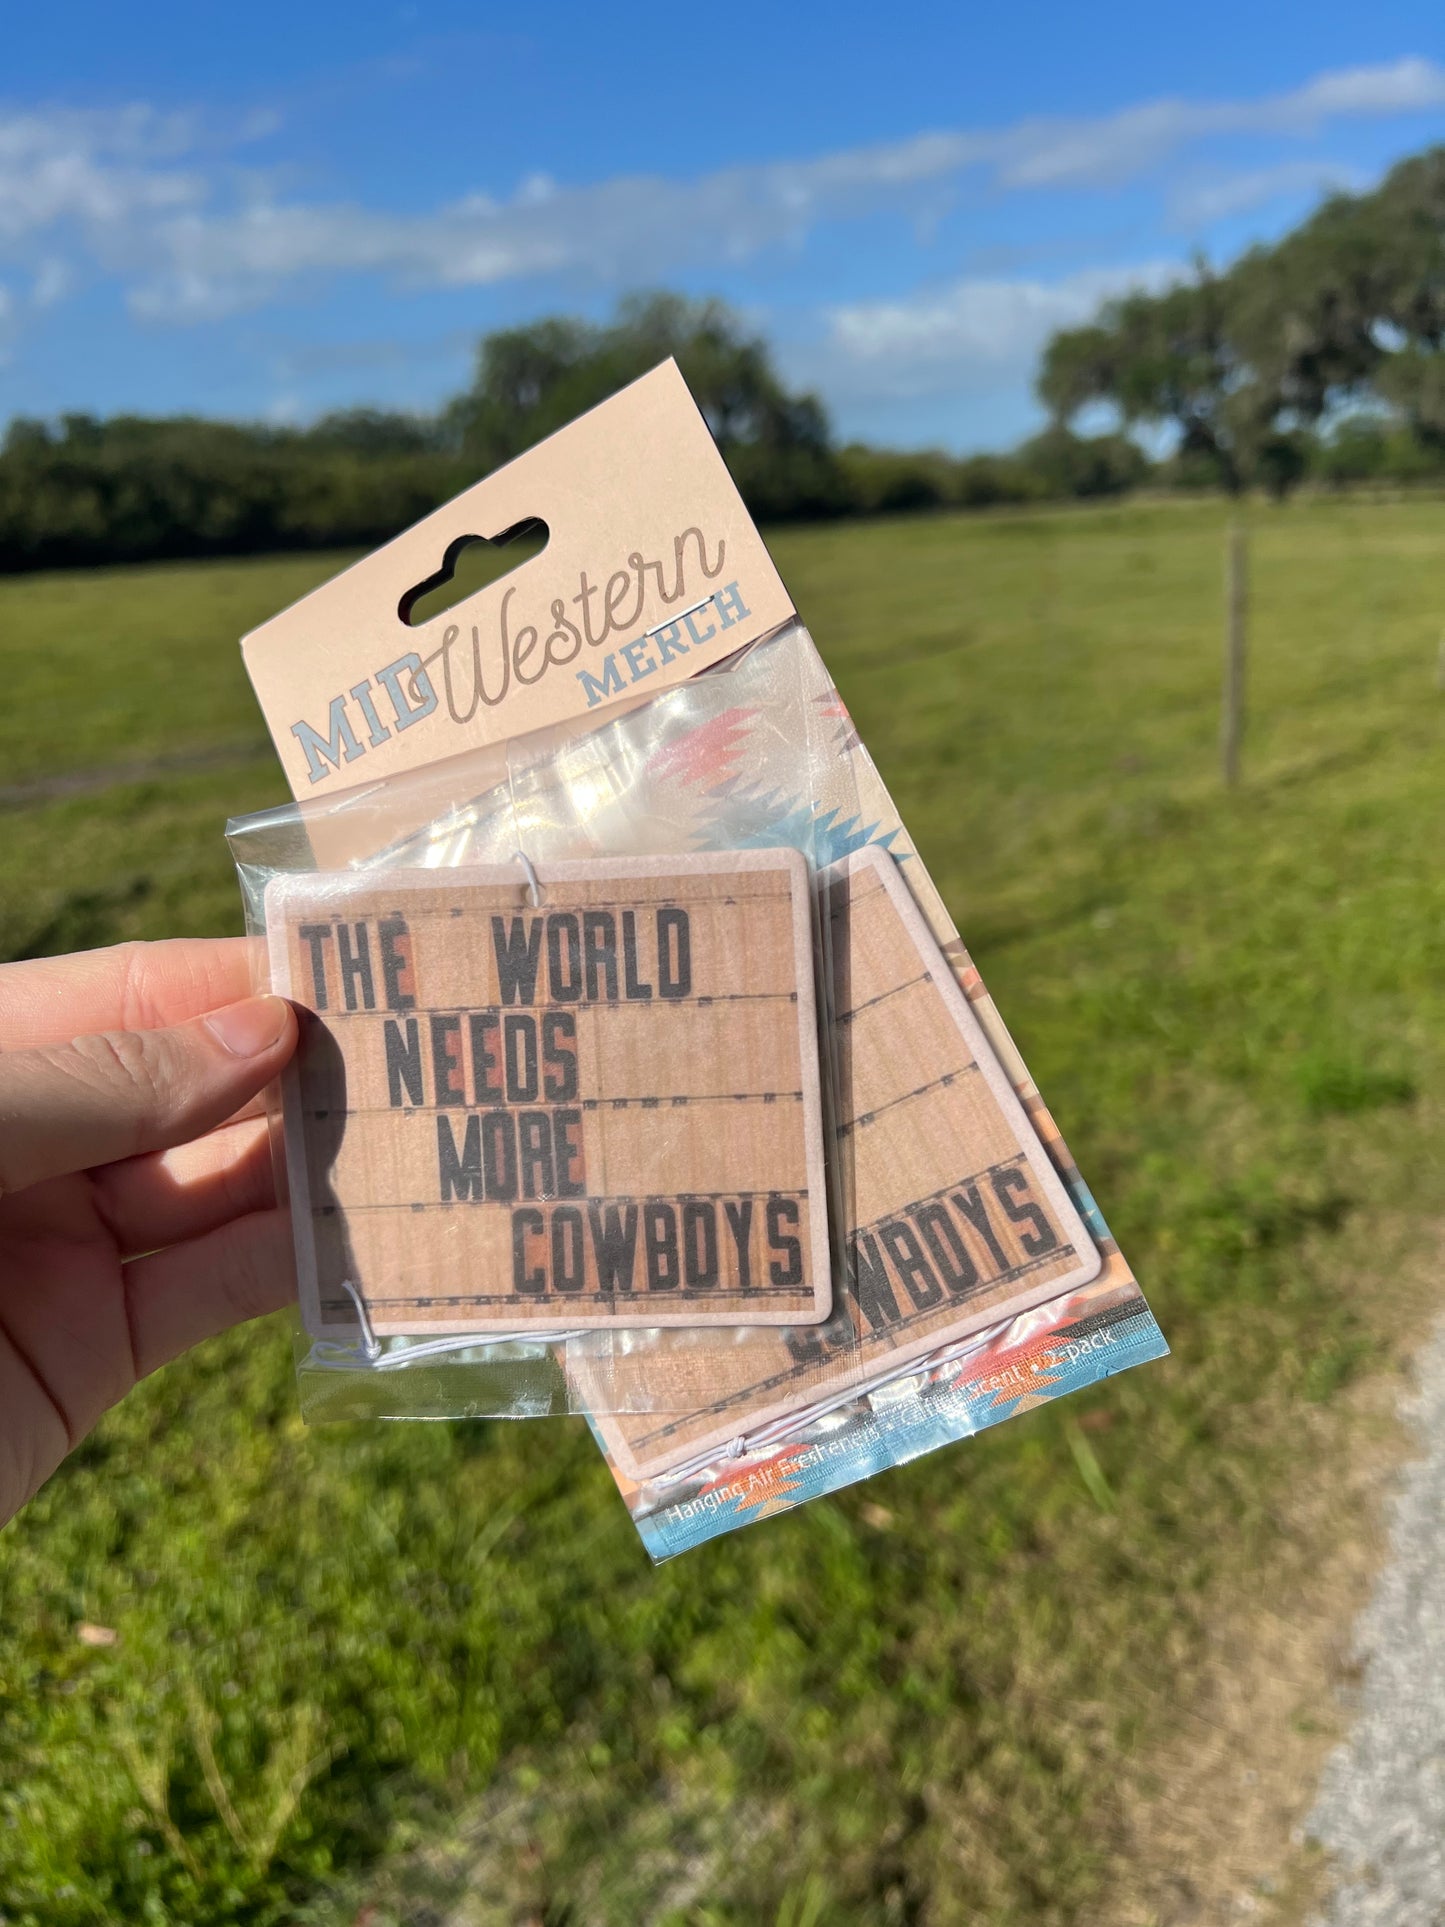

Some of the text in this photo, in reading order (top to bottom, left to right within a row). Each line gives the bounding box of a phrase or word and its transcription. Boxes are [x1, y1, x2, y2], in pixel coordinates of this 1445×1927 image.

[290, 526, 726, 783] MID Western
[576, 581, 752, 709] MERCH
[300, 908, 692, 1011] THE WORLD
[384, 1011, 578, 1108] NEEDS
[436, 1109, 586, 1202] MORE
[511, 1200, 803, 1294] COWBOYS
[785, 1167, 1057, 1361] WBOYS
[664, 1484, 745, 1524] Hanging
[748, 1467, 774, 1491] Air
[1044, 1326, 1118, 1369] 2-pack
